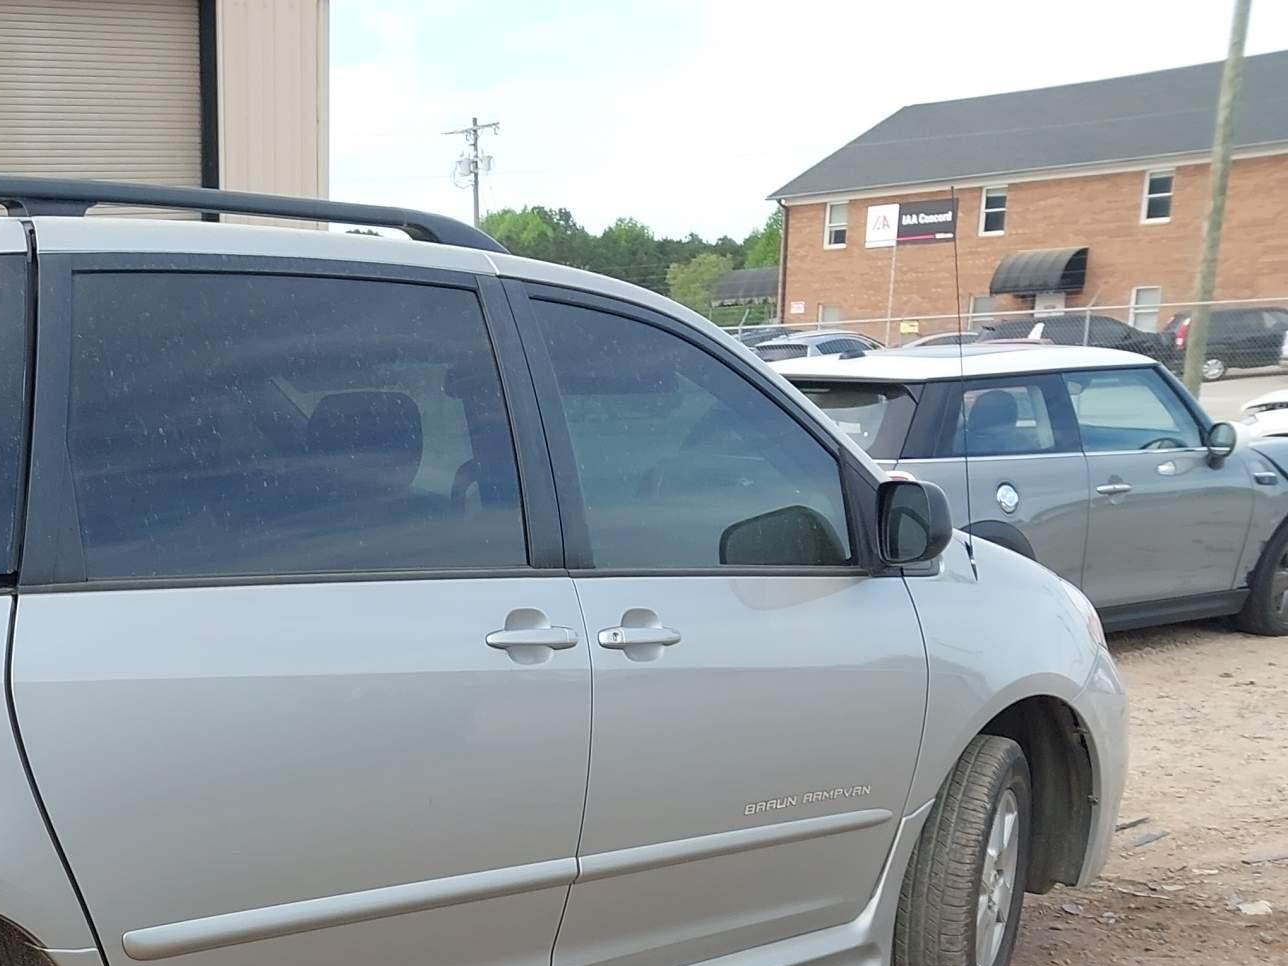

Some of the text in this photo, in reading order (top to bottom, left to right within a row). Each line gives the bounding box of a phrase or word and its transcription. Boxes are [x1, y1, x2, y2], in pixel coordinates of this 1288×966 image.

[902, 211, 952, 226] IAA Concord
[744, 785, 871, 815] BRAUN RAMPVAN
